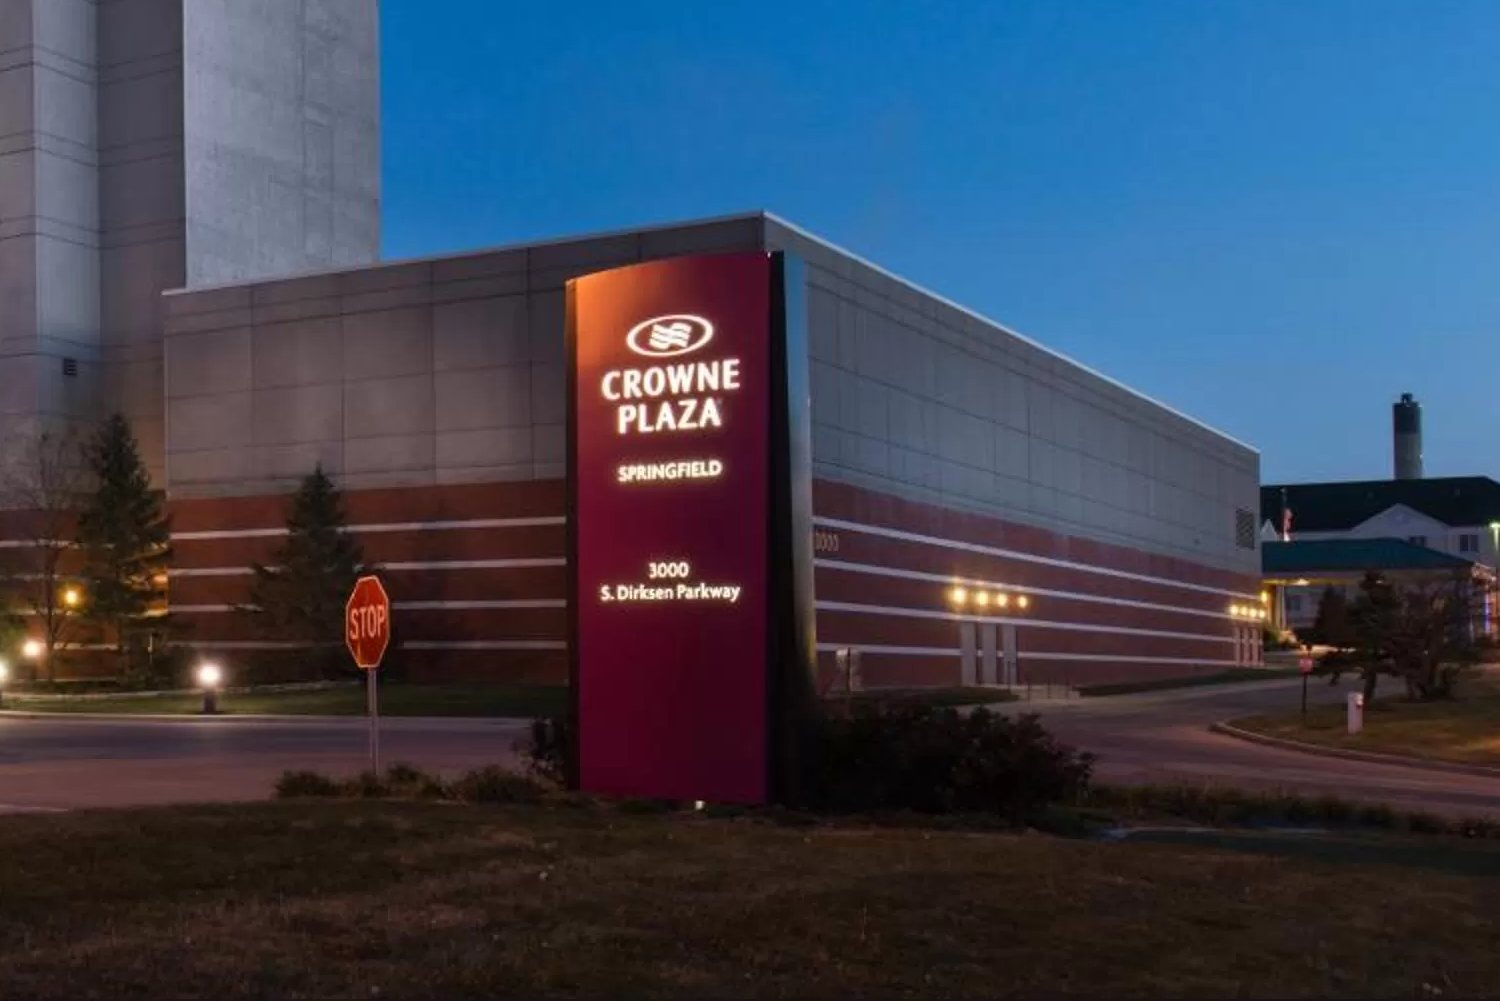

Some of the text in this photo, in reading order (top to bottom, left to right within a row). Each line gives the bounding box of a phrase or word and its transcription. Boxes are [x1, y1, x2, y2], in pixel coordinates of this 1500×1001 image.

[601, 359, 741, 401] CROWNE
[618, 398, 721, 434] PLAZA
[618, 460, 722, 482] SPRINGFIELD
[648, 562, 690, 579] 3000
[600, 583, 741, 603] S. Dirksen Parkway
[349, 605, 385, 640] STOP
